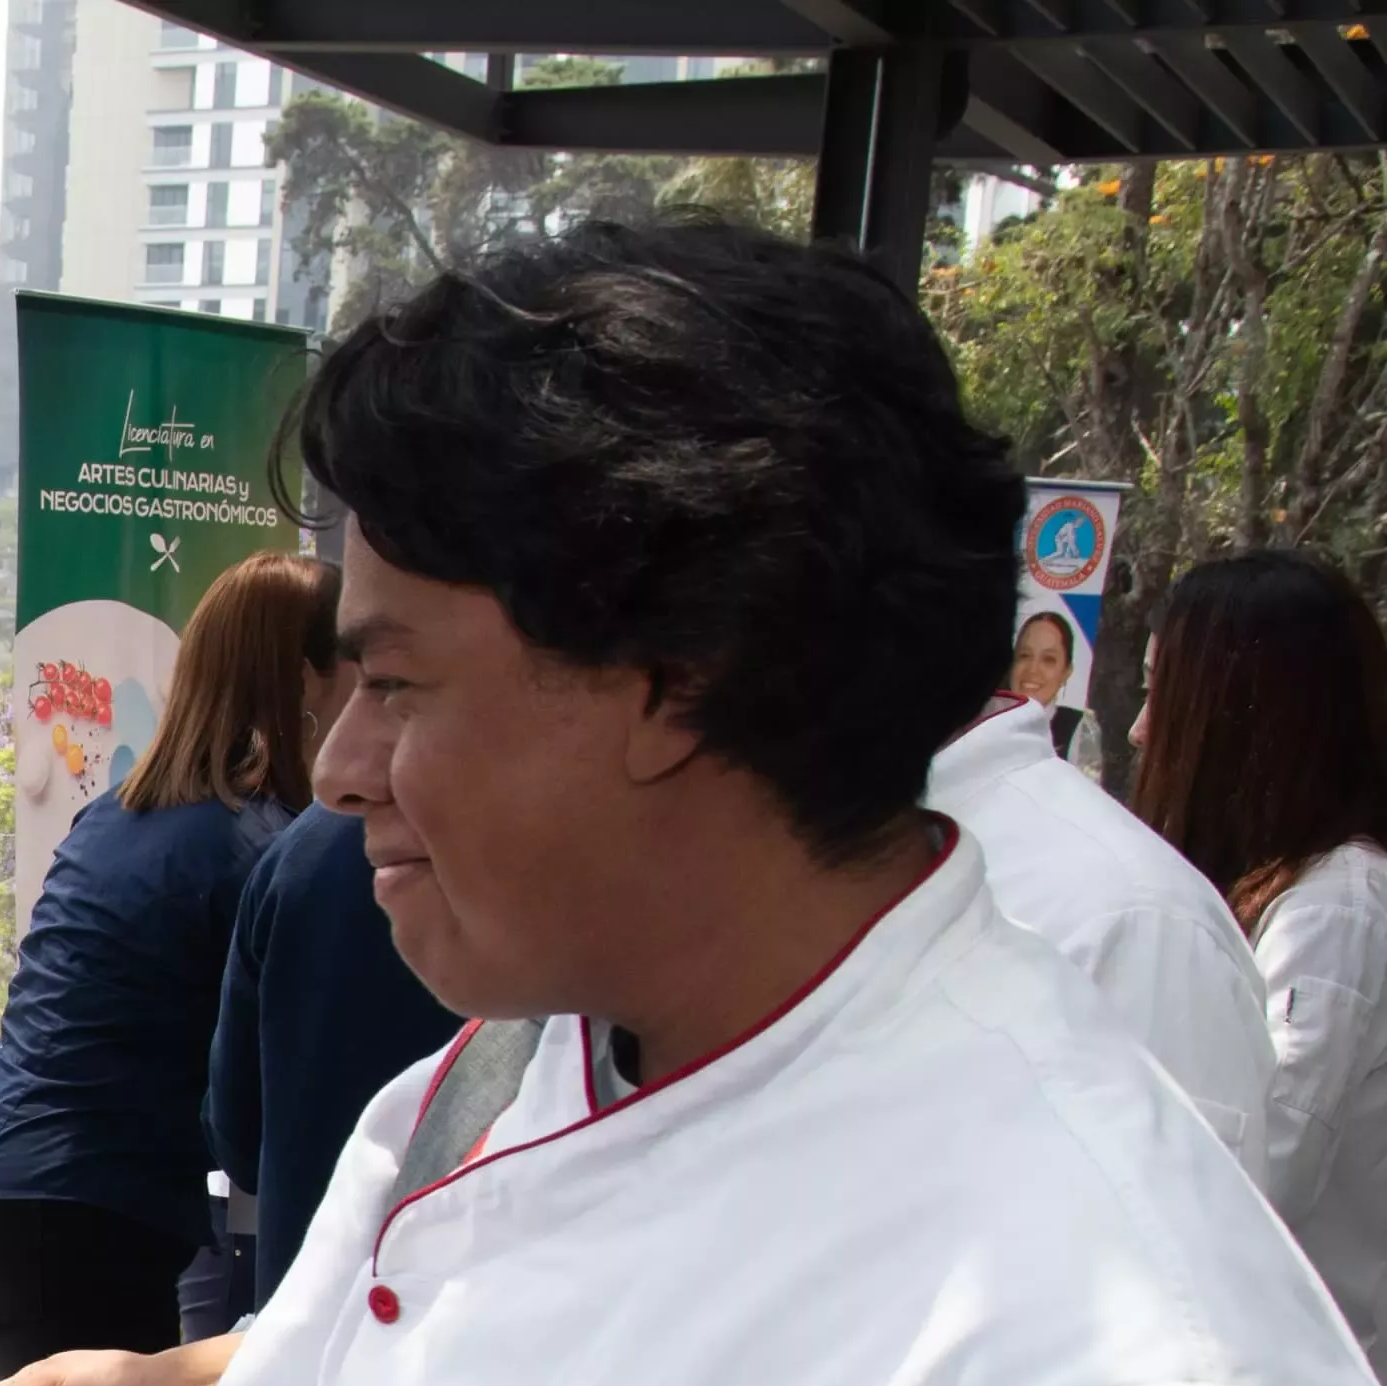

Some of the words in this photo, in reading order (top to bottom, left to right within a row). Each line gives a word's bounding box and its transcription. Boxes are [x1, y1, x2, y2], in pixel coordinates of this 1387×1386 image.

[119, 388, 195, 462] Licenciatura
[200, 433, 214, 449] en
[78, 463, 135, 486] ARTES
[137, 468, 236, 495] CULINARIAS
[239, 481, 249, 502] y
[40, 489, 133, 516] NEGOCIOS
[135, 498, 277, 527] GASTRONÓMICOS
